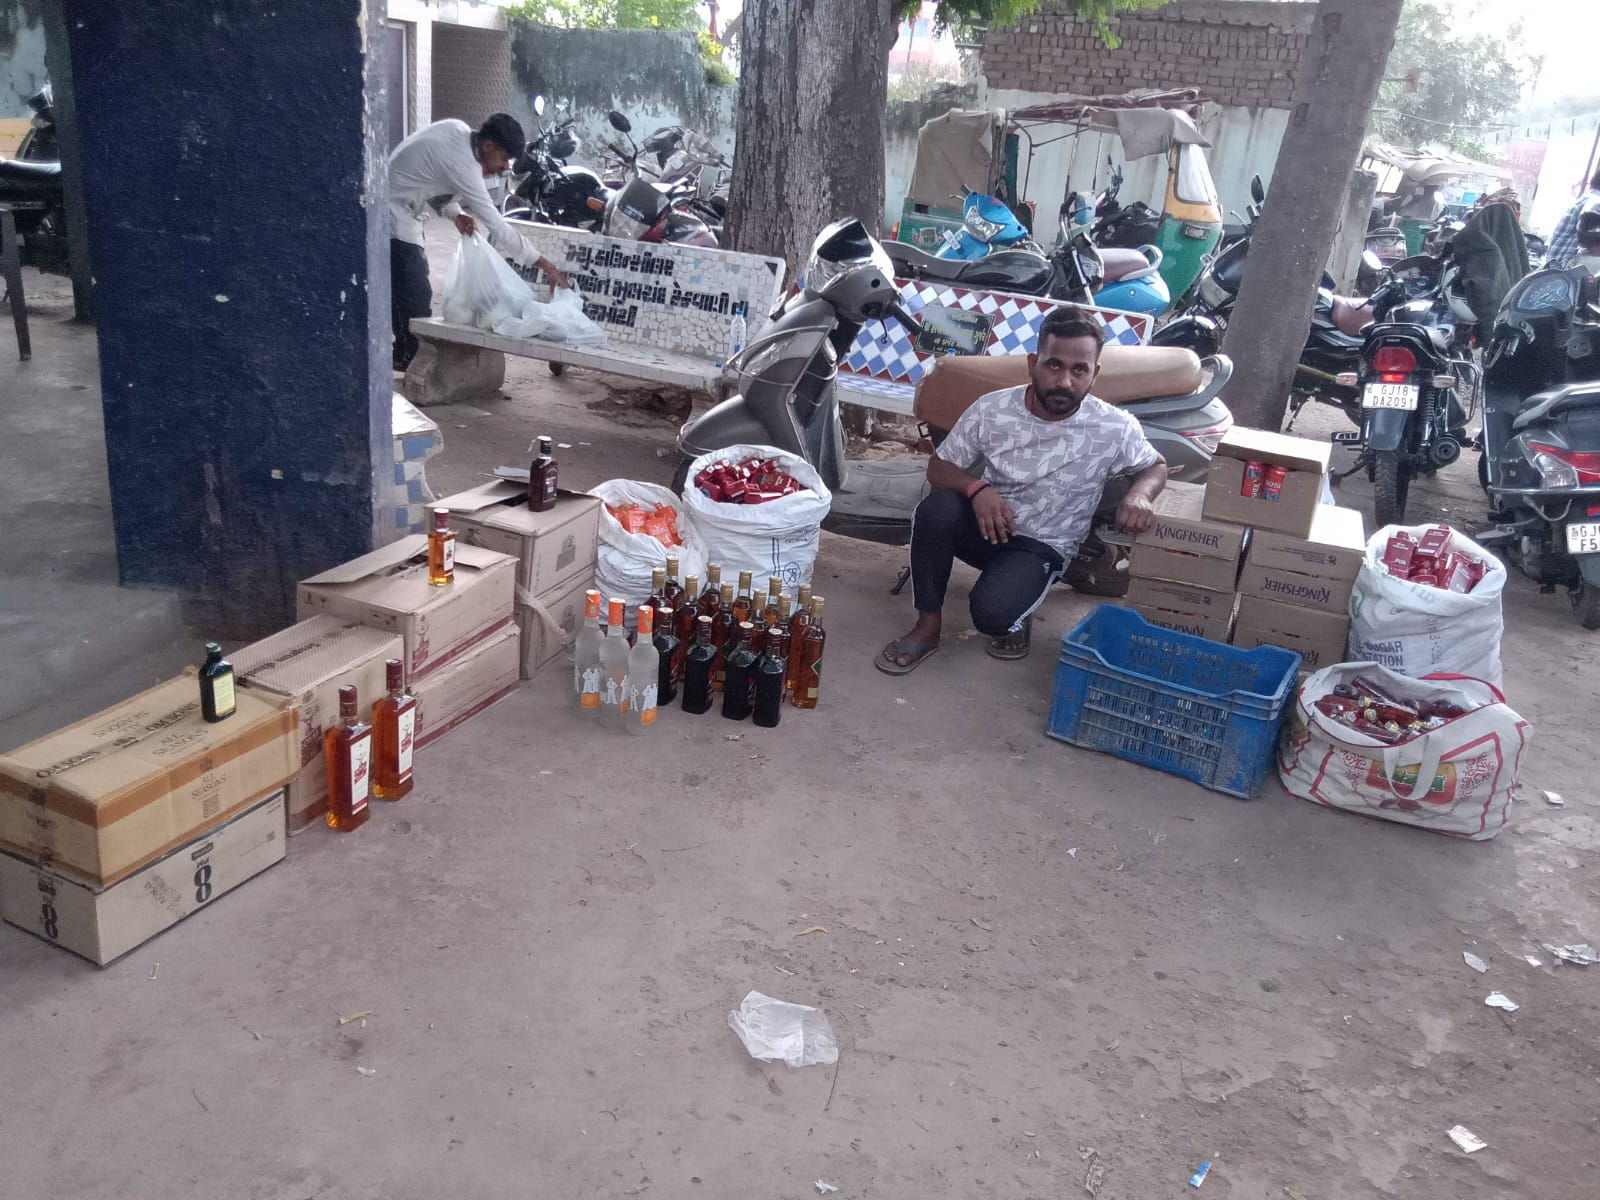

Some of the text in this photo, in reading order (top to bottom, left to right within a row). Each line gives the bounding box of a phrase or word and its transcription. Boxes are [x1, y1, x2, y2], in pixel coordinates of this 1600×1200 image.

[1381, 385, 1409, 396] GJ18
[1372, 395, 1413, 409] DA2091
[1155, 523, 1219, 549] KINGFISHER
[1580, 525, 1600, 538] GJ
[1264, 576, 1331, 603] KINGFISHER
[194, 865, 212, 903] 8
